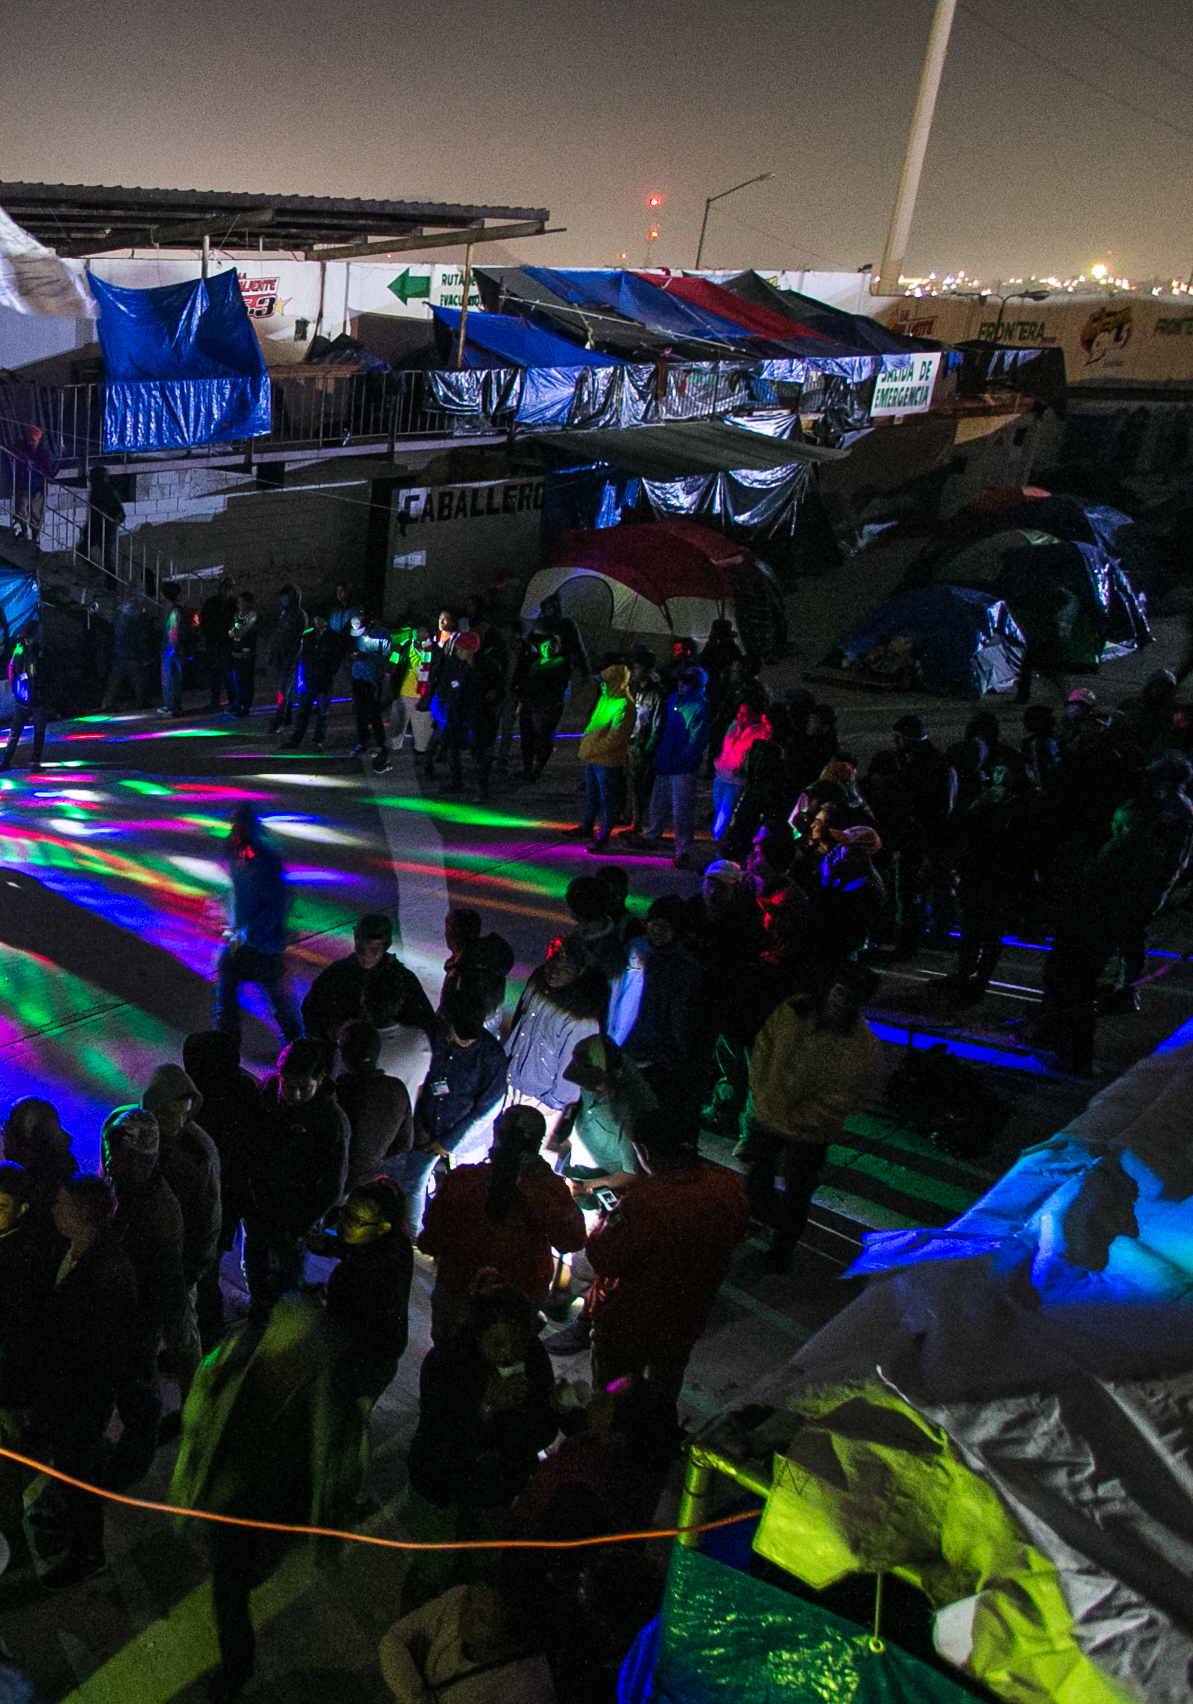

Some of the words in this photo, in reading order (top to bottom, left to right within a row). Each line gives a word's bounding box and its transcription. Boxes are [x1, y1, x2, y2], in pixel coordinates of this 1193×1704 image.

[977, 320, 1046, 342] FRONTERA
[919, 360, 933, 381] DE
[874, 385, 930, 408] EMERGENCIA
